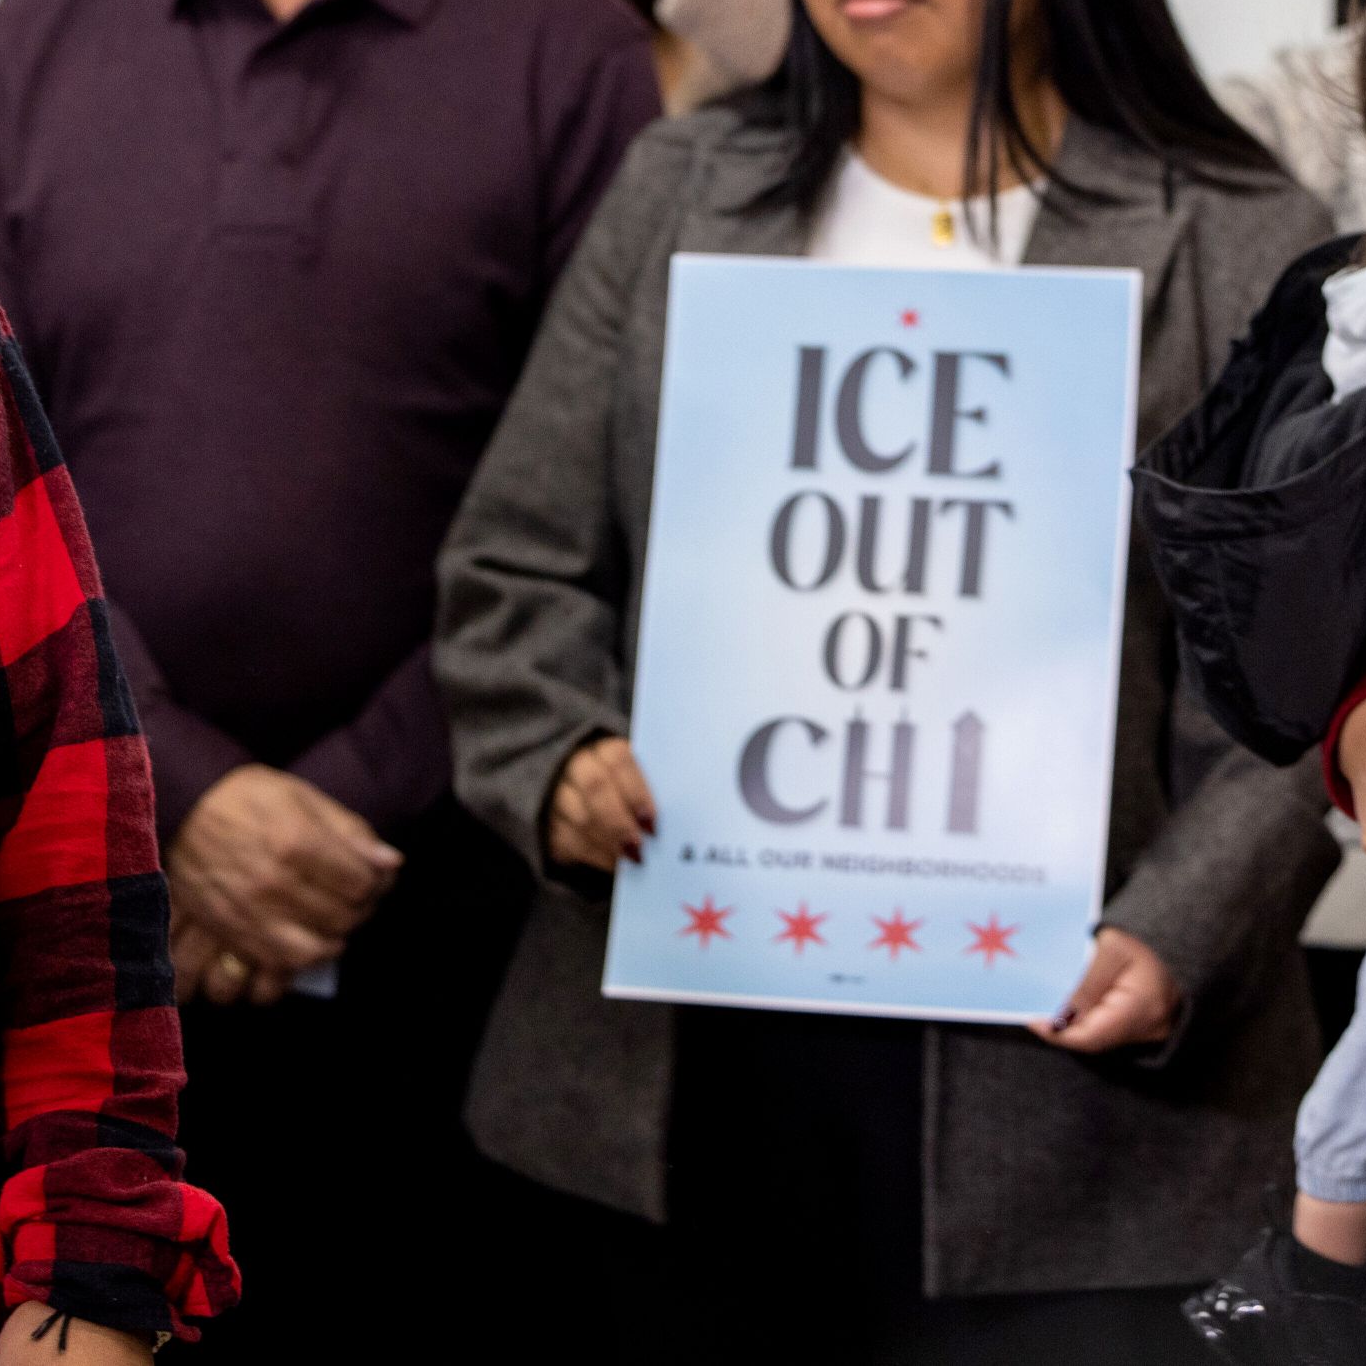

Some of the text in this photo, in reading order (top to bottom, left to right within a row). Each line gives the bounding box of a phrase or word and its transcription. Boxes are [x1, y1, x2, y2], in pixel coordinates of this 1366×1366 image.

[787, 343, 1014, 481] ICE
[766, 488, 1016, 600] OUT
[819, 608, 946, 695] OF
[736, 705, 988, 835] CHI
[703, 841, 750, 869] ALL
[756, 845, 815, 871] OUR
[820, 850, 1047, 886] NEIGHBORHOODS
